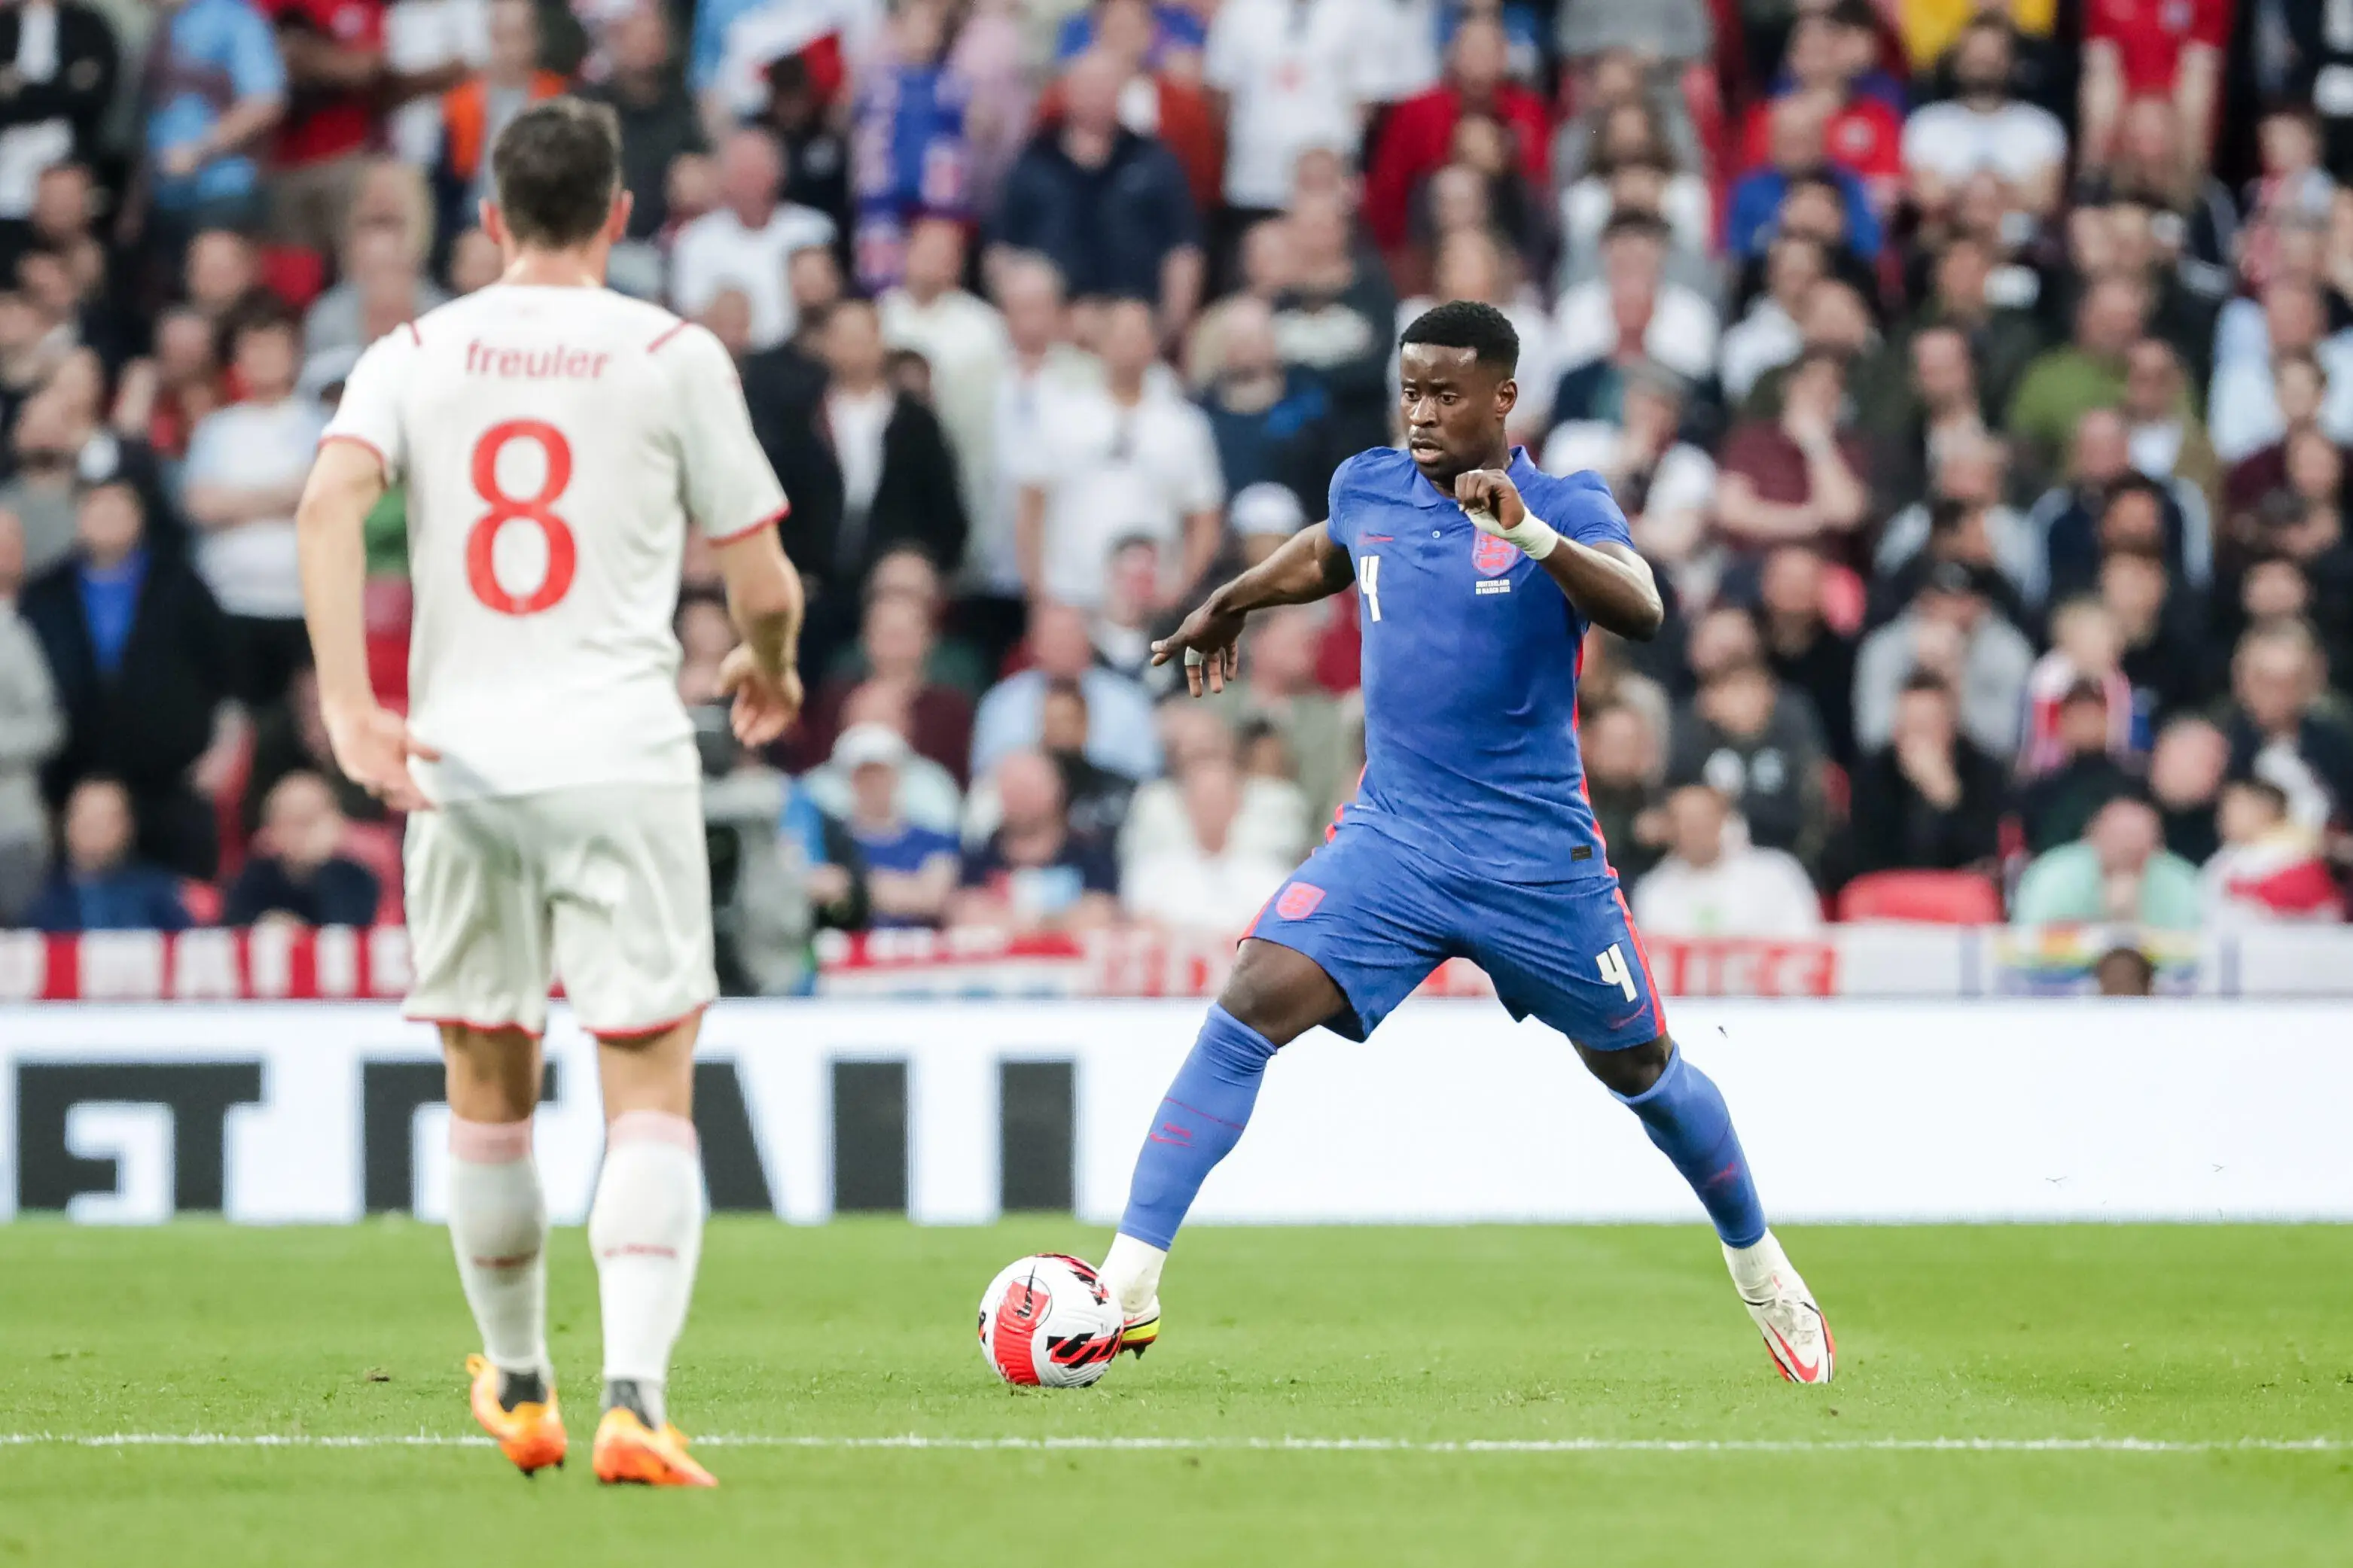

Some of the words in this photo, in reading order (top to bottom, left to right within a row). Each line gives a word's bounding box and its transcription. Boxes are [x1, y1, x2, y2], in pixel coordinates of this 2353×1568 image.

[465, 339, 611, 379] freuler
[465, 418, 578, 618] 8
[1359, 555, 1382, 623] 4
[1596, 942, 1638, 1003] 4
